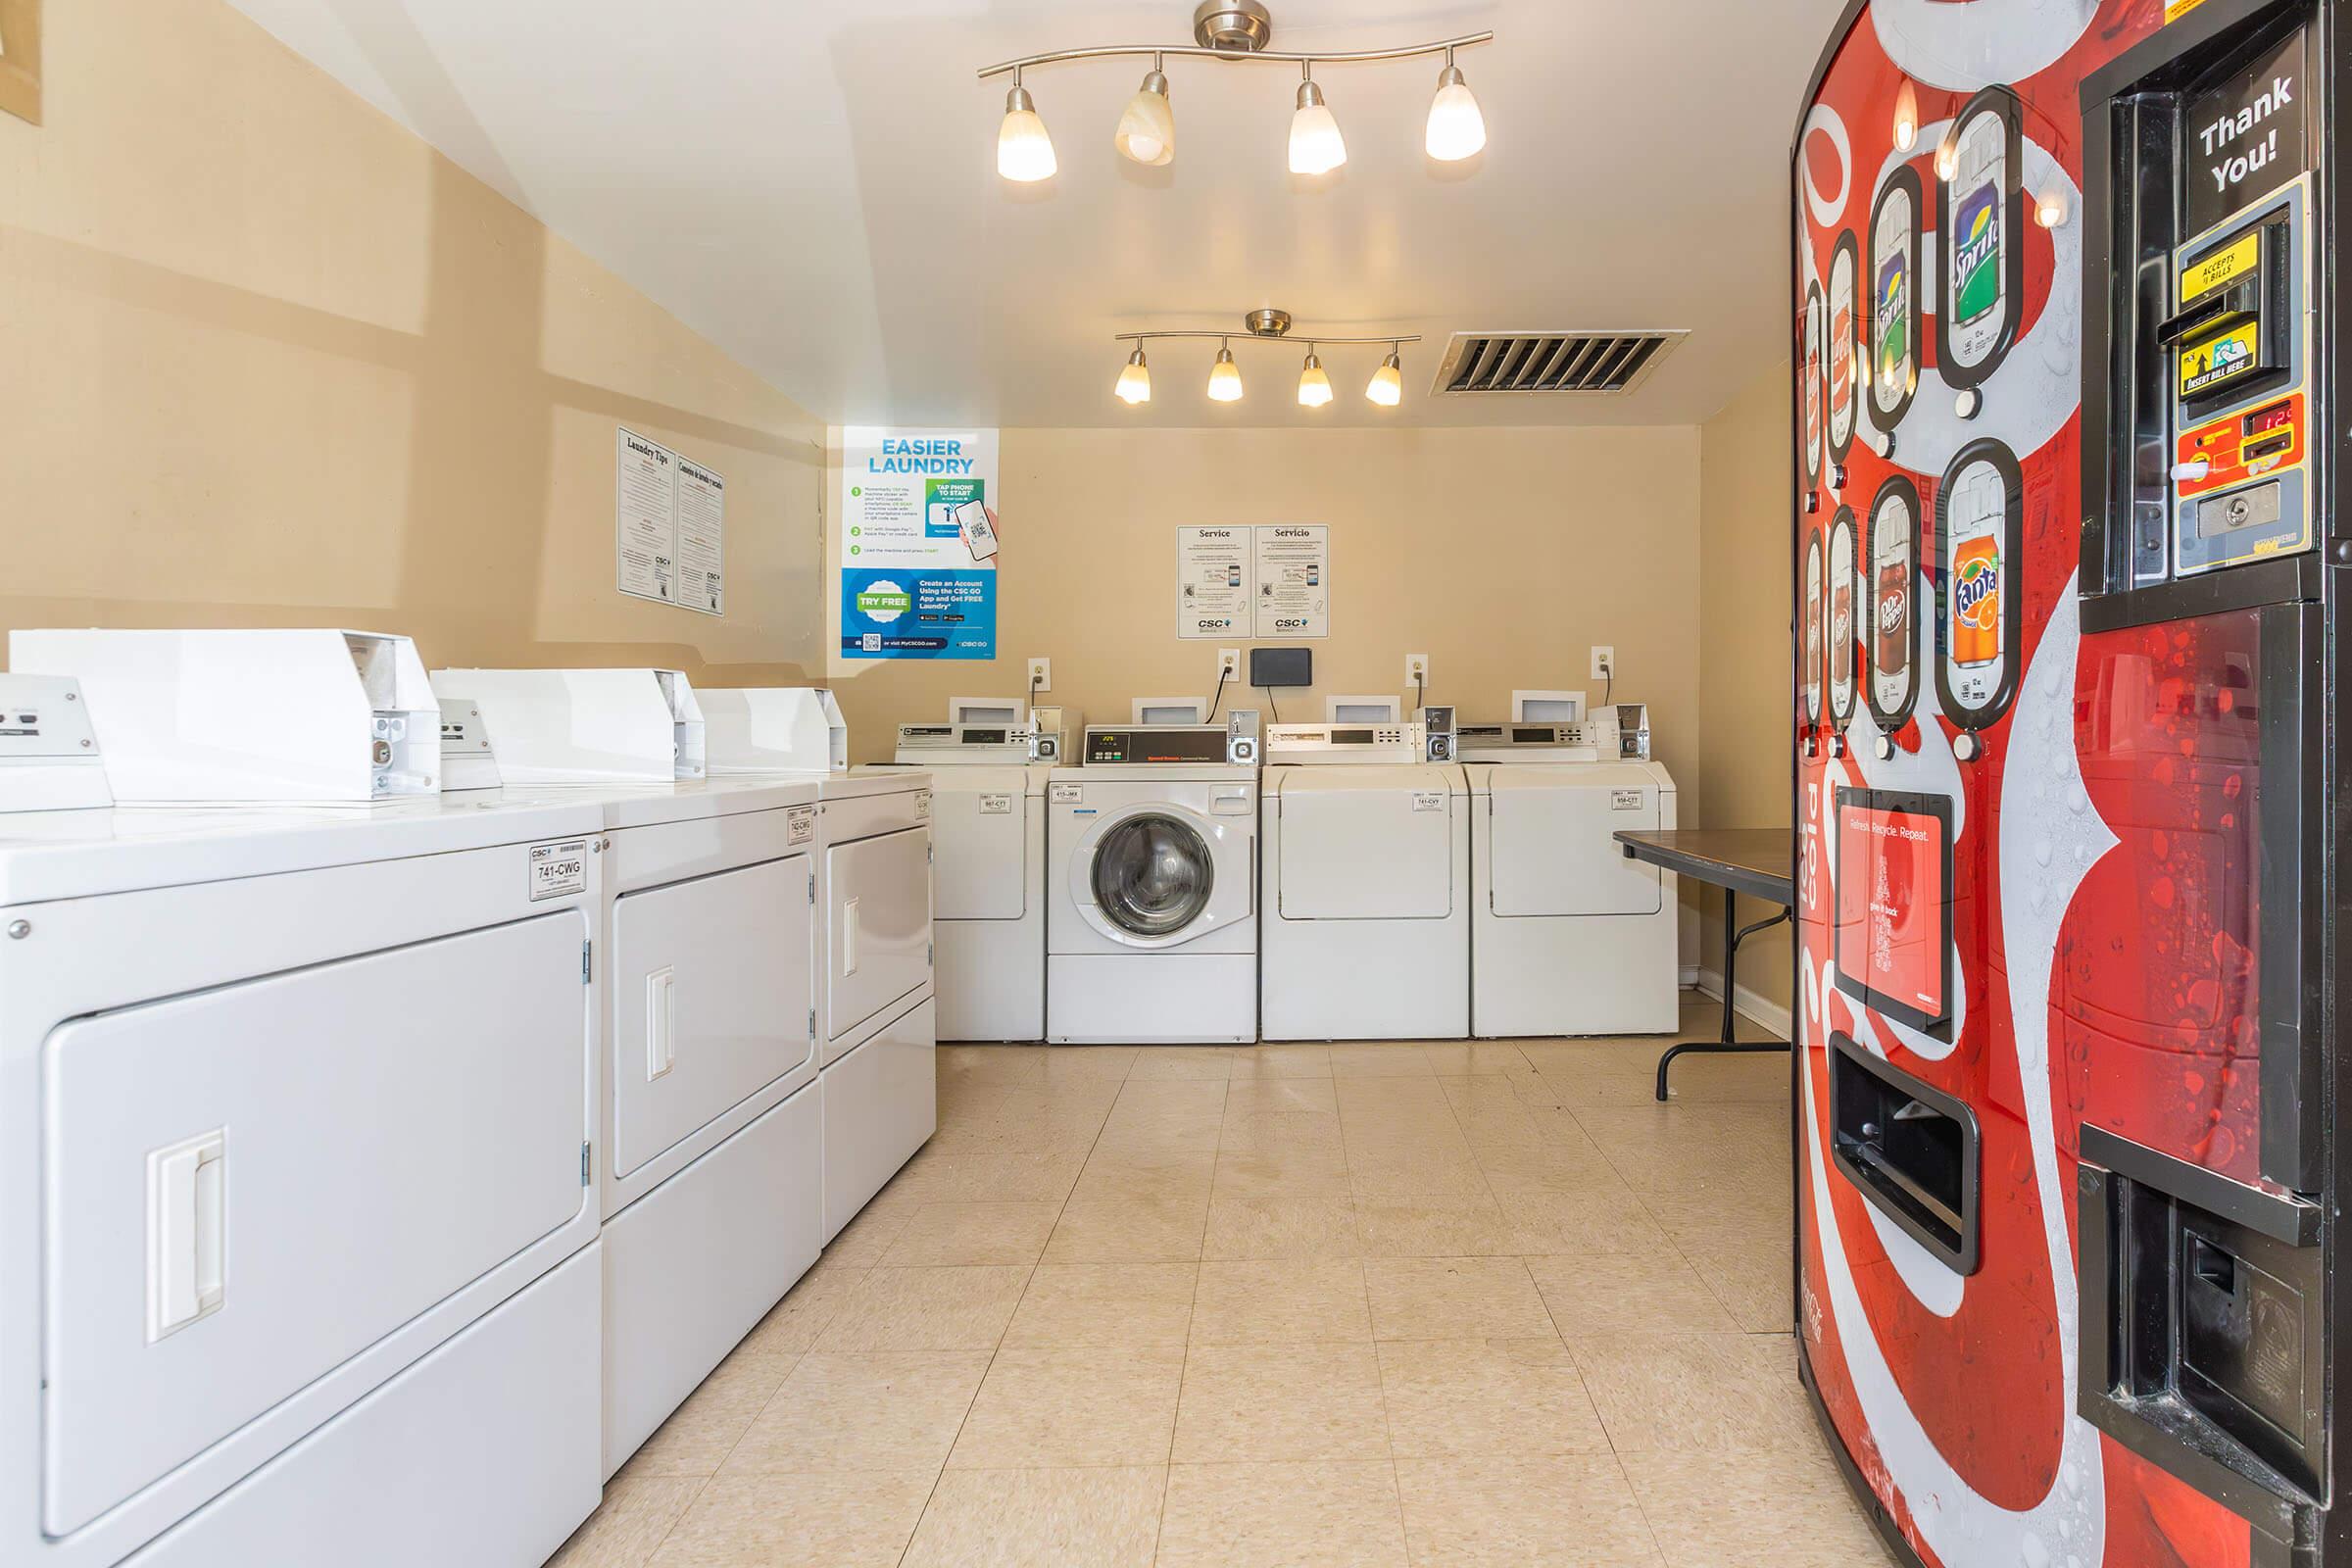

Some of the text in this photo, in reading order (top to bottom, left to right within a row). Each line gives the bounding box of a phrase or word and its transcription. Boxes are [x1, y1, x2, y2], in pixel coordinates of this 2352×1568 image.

[2200, 76, 2292, 157] Thank
[2211, 128, 2277, 193] You!
[1955, 220, 1998, 289] Sprite
[2202, 253, 2234, 276] ACCEPTS
[2210, 264, 2231, 282] BILLS
[2186, 360, 2246, 390] INSERT BILL HERE
[626, 437, 668, 466] Laundry Tips
[882, 439, 961, 456] EASIER
[869, 458, 973, 474] LAUNDRY
[1199, 529, 1231, 538] Service
[1275, 528, 1310, 537] Servicio
[859, 597, 908, 606] TRY FREE
[1198, 619, 1224, 628] CSC
[1275, 618, 1301, 627] CSC
[1899, 826, 1930, 843] Repeat.
[532, 849, 547, 858] CSC
[1807, 782, 1818, 910] cold
[538, 861, 580, 879] 741-CWG
